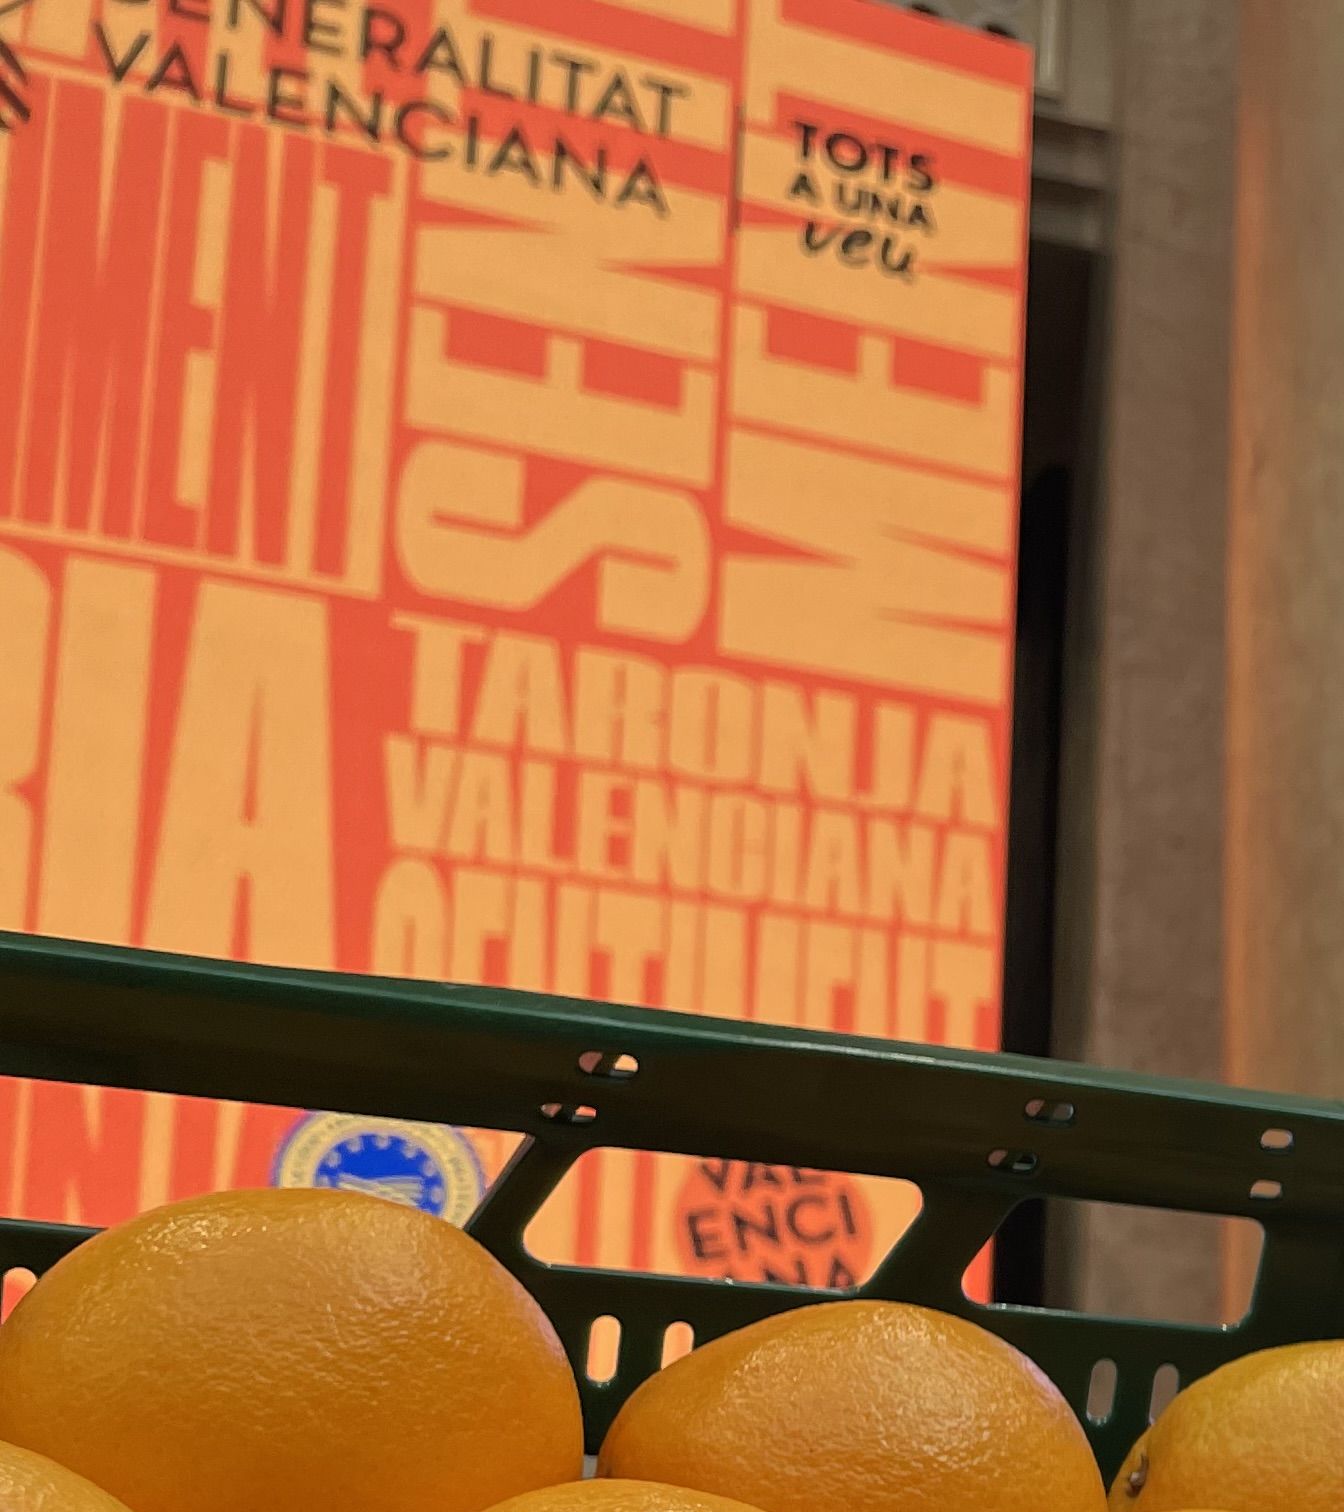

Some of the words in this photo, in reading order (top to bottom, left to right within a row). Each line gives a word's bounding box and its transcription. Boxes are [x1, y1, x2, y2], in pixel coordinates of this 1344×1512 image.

[92, 20, 670, 217] VALENCIANA
[105, 0, 692, 139] NERALITAT
[789, 172, 818, 200] A
[836, 180, 935, 231] UNA
[793, 118, 934, 192] TOTS
[803, 220, 915, 284] veu
[390, 611, 998, 827] TARONJA
[384, 731, 996, 937] VALENCIANA
[687, 1193, 857, 1260] ENCI
